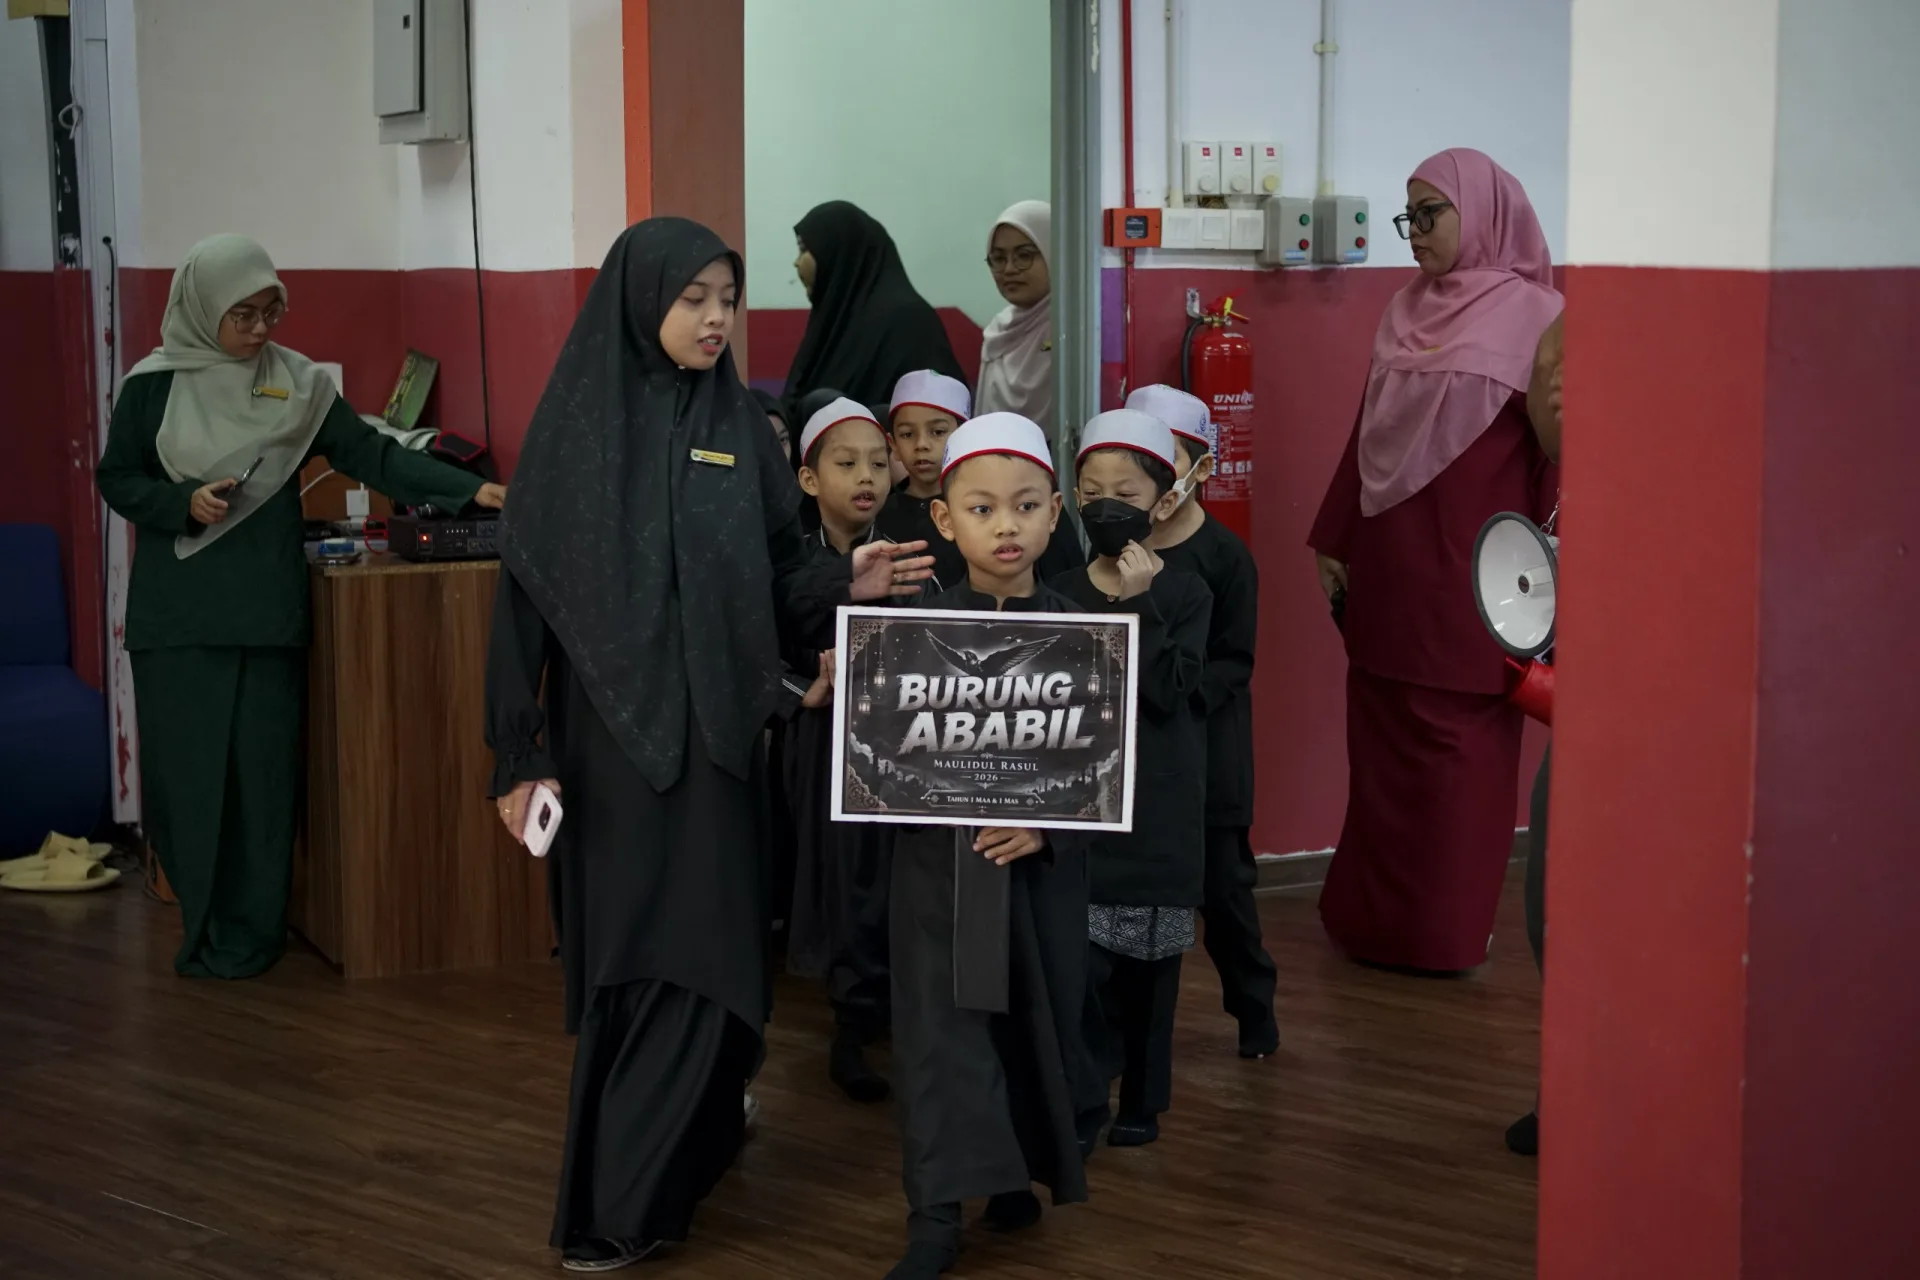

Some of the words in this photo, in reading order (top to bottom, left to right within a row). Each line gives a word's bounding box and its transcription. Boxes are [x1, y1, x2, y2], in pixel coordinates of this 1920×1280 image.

[896, 672, 1076, 711] BURUNG
[897, 705, 1096, 755] ABABIL
[933, 759, 996, 770] MAULIDUL
[1000, 760, 1039, 771] RASUL
[974, 773, 998, 781] 2026
[947, 795, 969, 803] TAHUN
